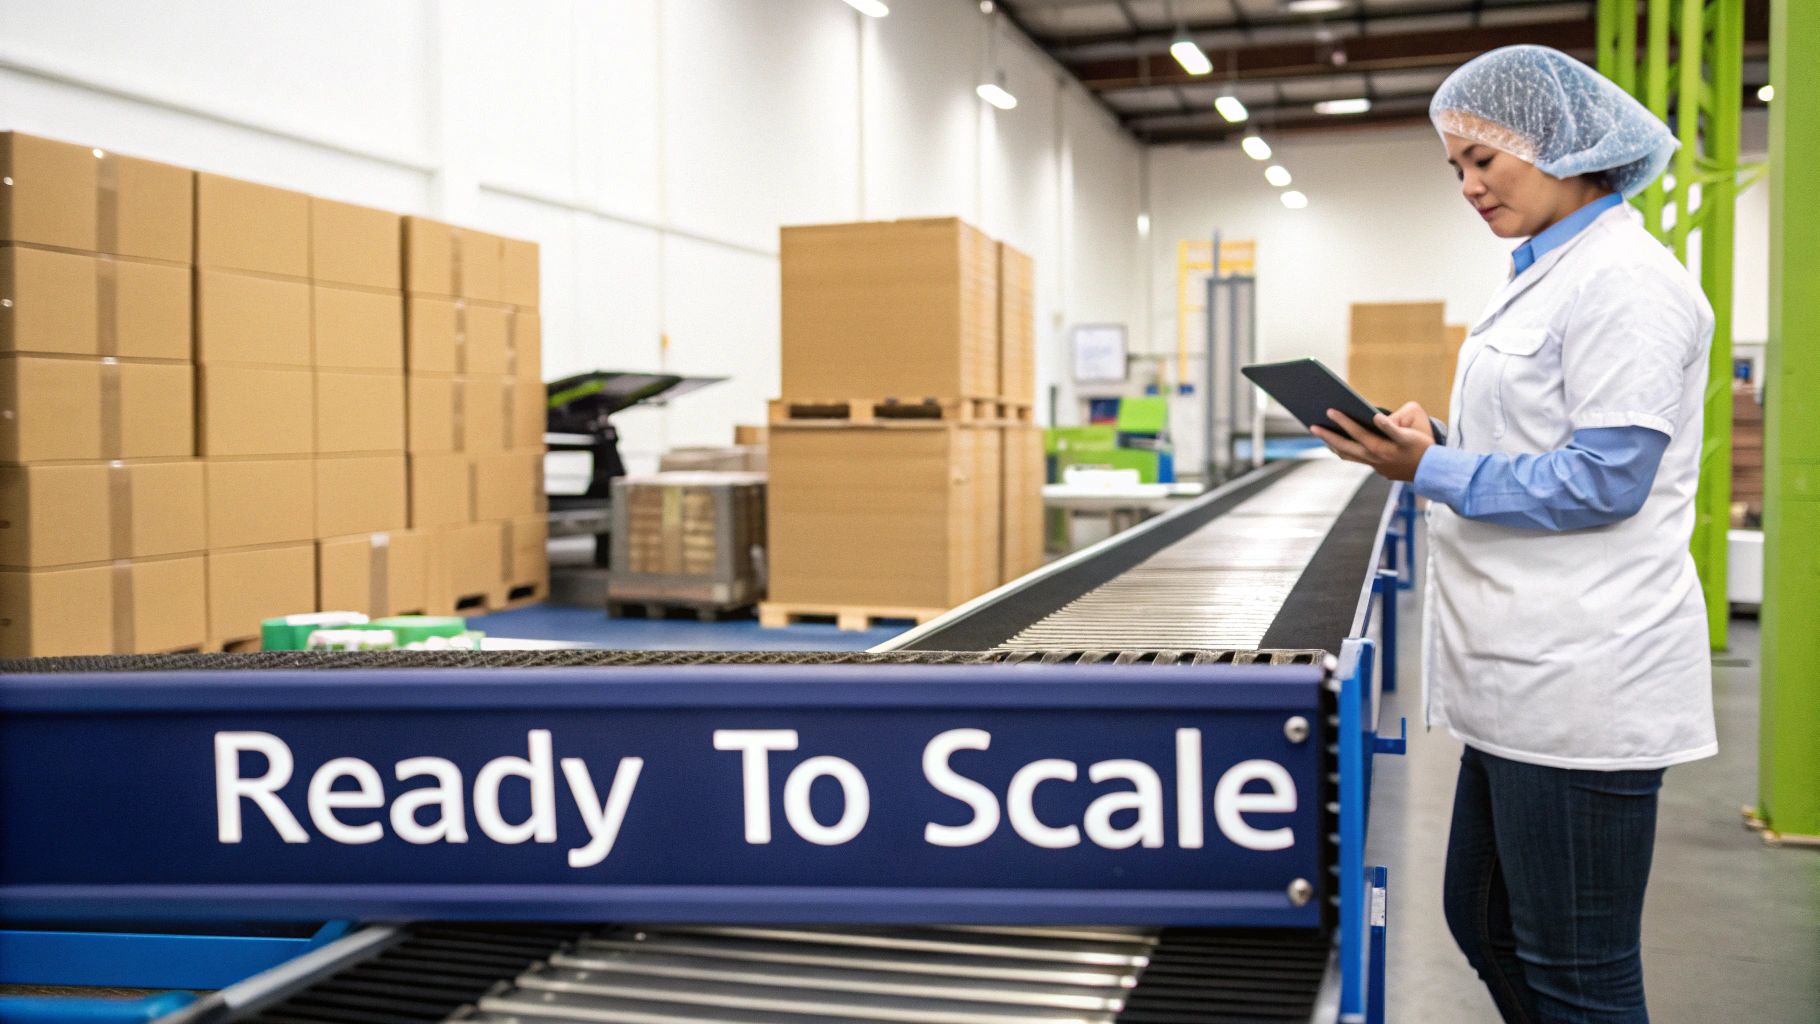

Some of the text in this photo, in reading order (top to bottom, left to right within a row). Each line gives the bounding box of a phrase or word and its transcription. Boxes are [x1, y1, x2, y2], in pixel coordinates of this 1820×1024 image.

[214, 728, 1296, 868] Ready To Scale
